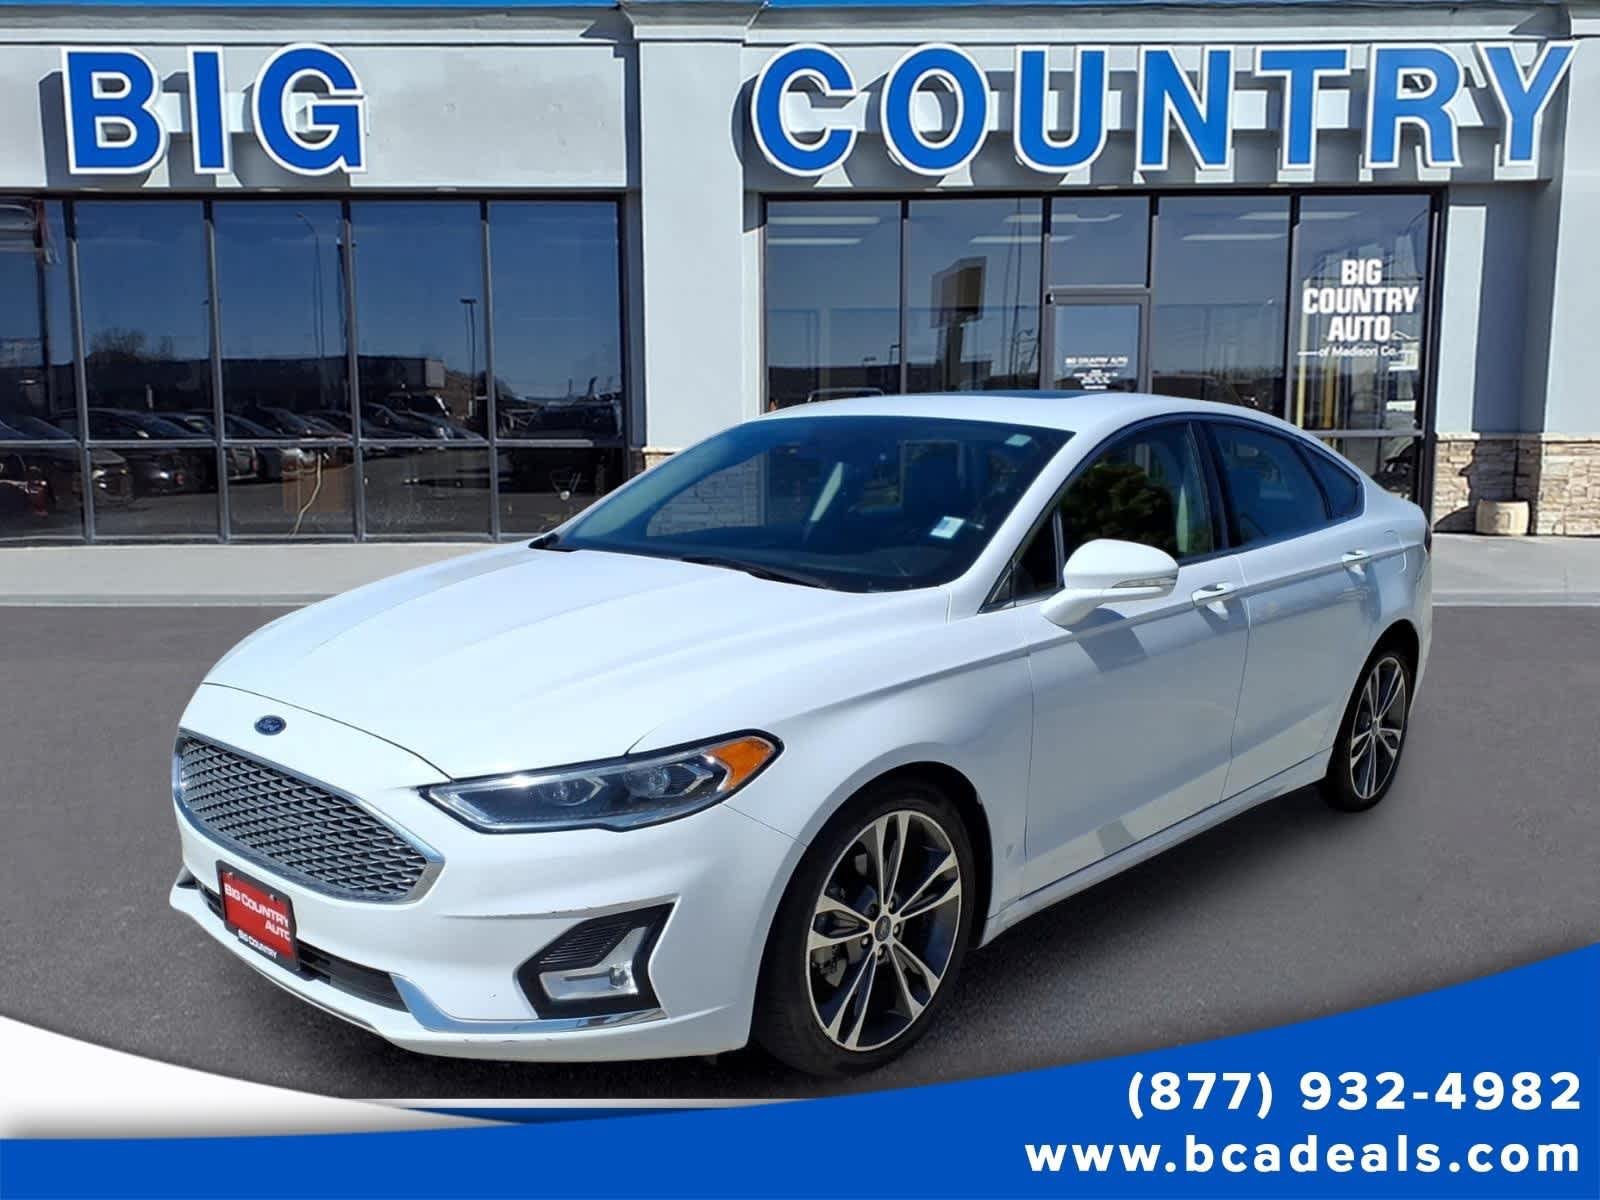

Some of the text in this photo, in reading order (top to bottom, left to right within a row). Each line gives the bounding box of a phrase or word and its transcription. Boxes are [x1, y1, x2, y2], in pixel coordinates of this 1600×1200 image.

[61, 43, 1576, 177] BIG COUNTRY
[1341, 258, 1383, 286] BIG
[1303, 287, 1420, 314] COUNTRY
[1327, 315, 1392, 341] AUTO
[1331, 346, 1378, 357] Madison
[224, 882, 289, 929] BIG COUNTRY
